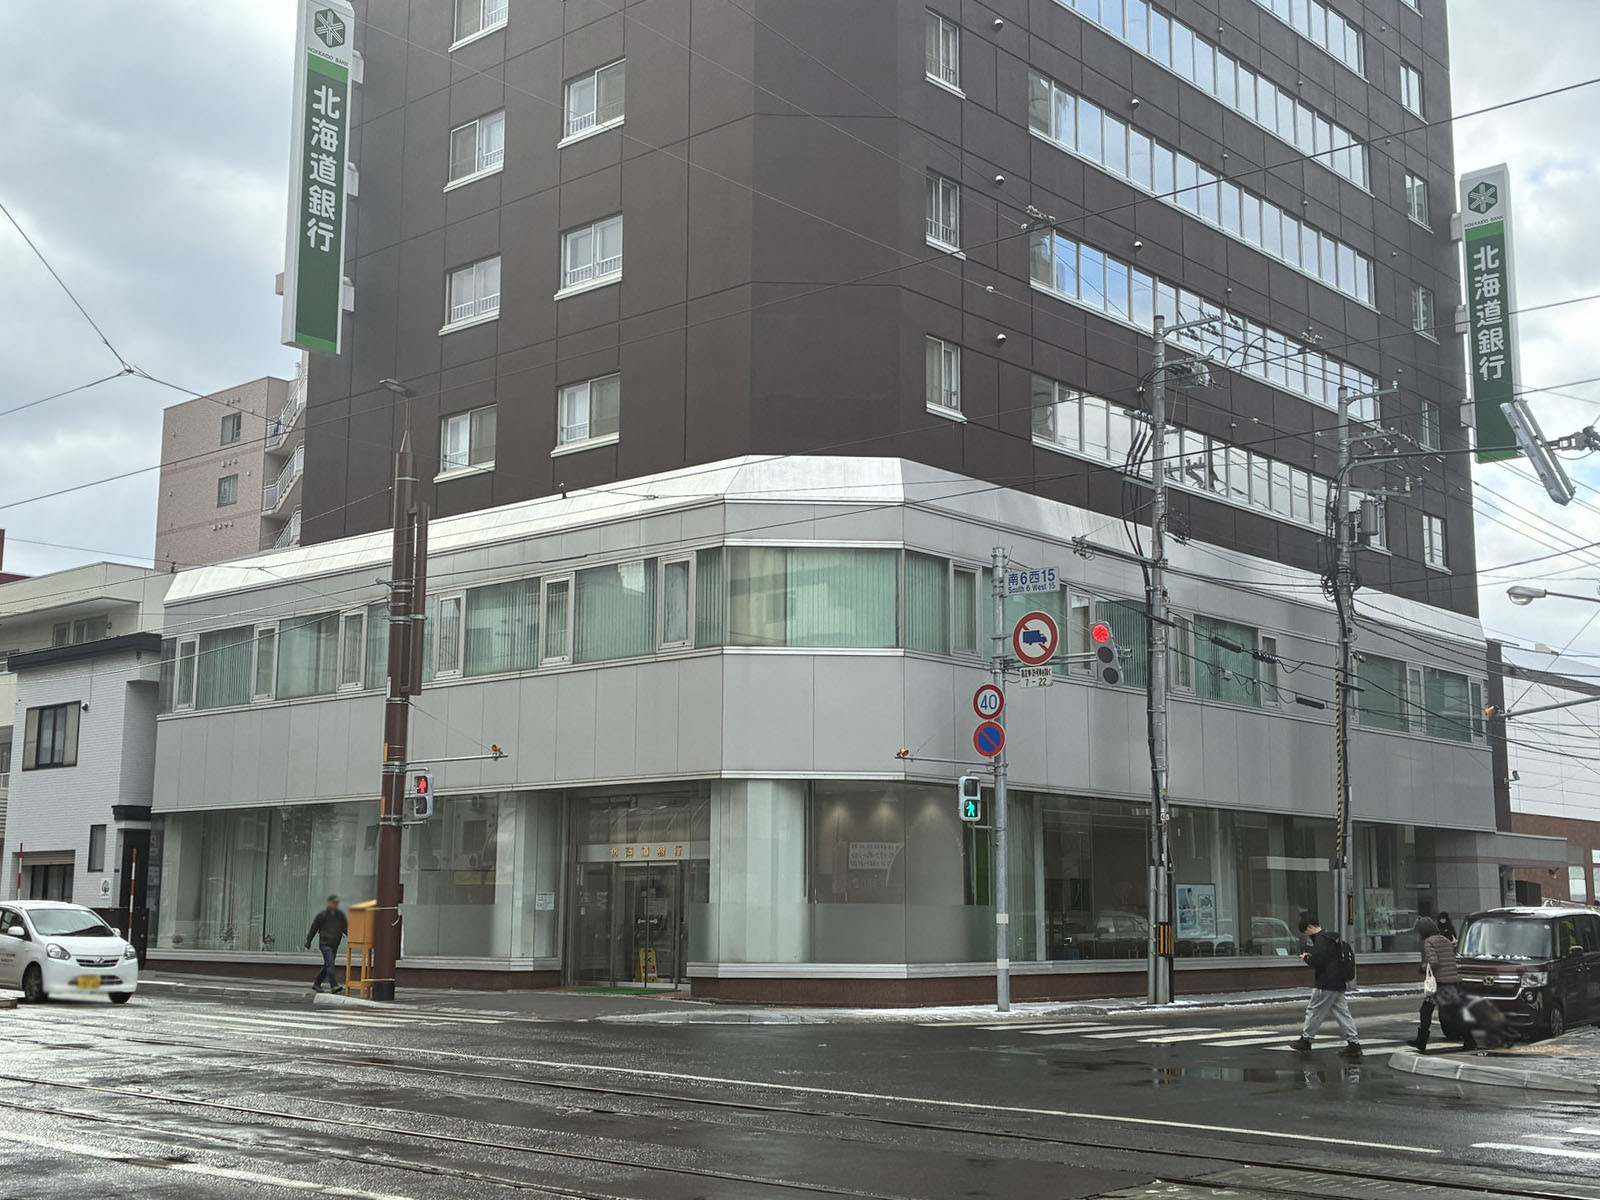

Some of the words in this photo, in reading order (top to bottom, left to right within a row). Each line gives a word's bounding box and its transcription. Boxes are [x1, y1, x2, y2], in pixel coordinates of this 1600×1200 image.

[307, 84, 341, 252] 北海道銀行
[1473, 245, 1505, 381] 北海道銀行
[1008, 568, 1055, 586] 南6西15
[1008, 585, 1024, 594] South
[1032, 583, 1047, 591] West
[980, 694, 997, 710] 40
